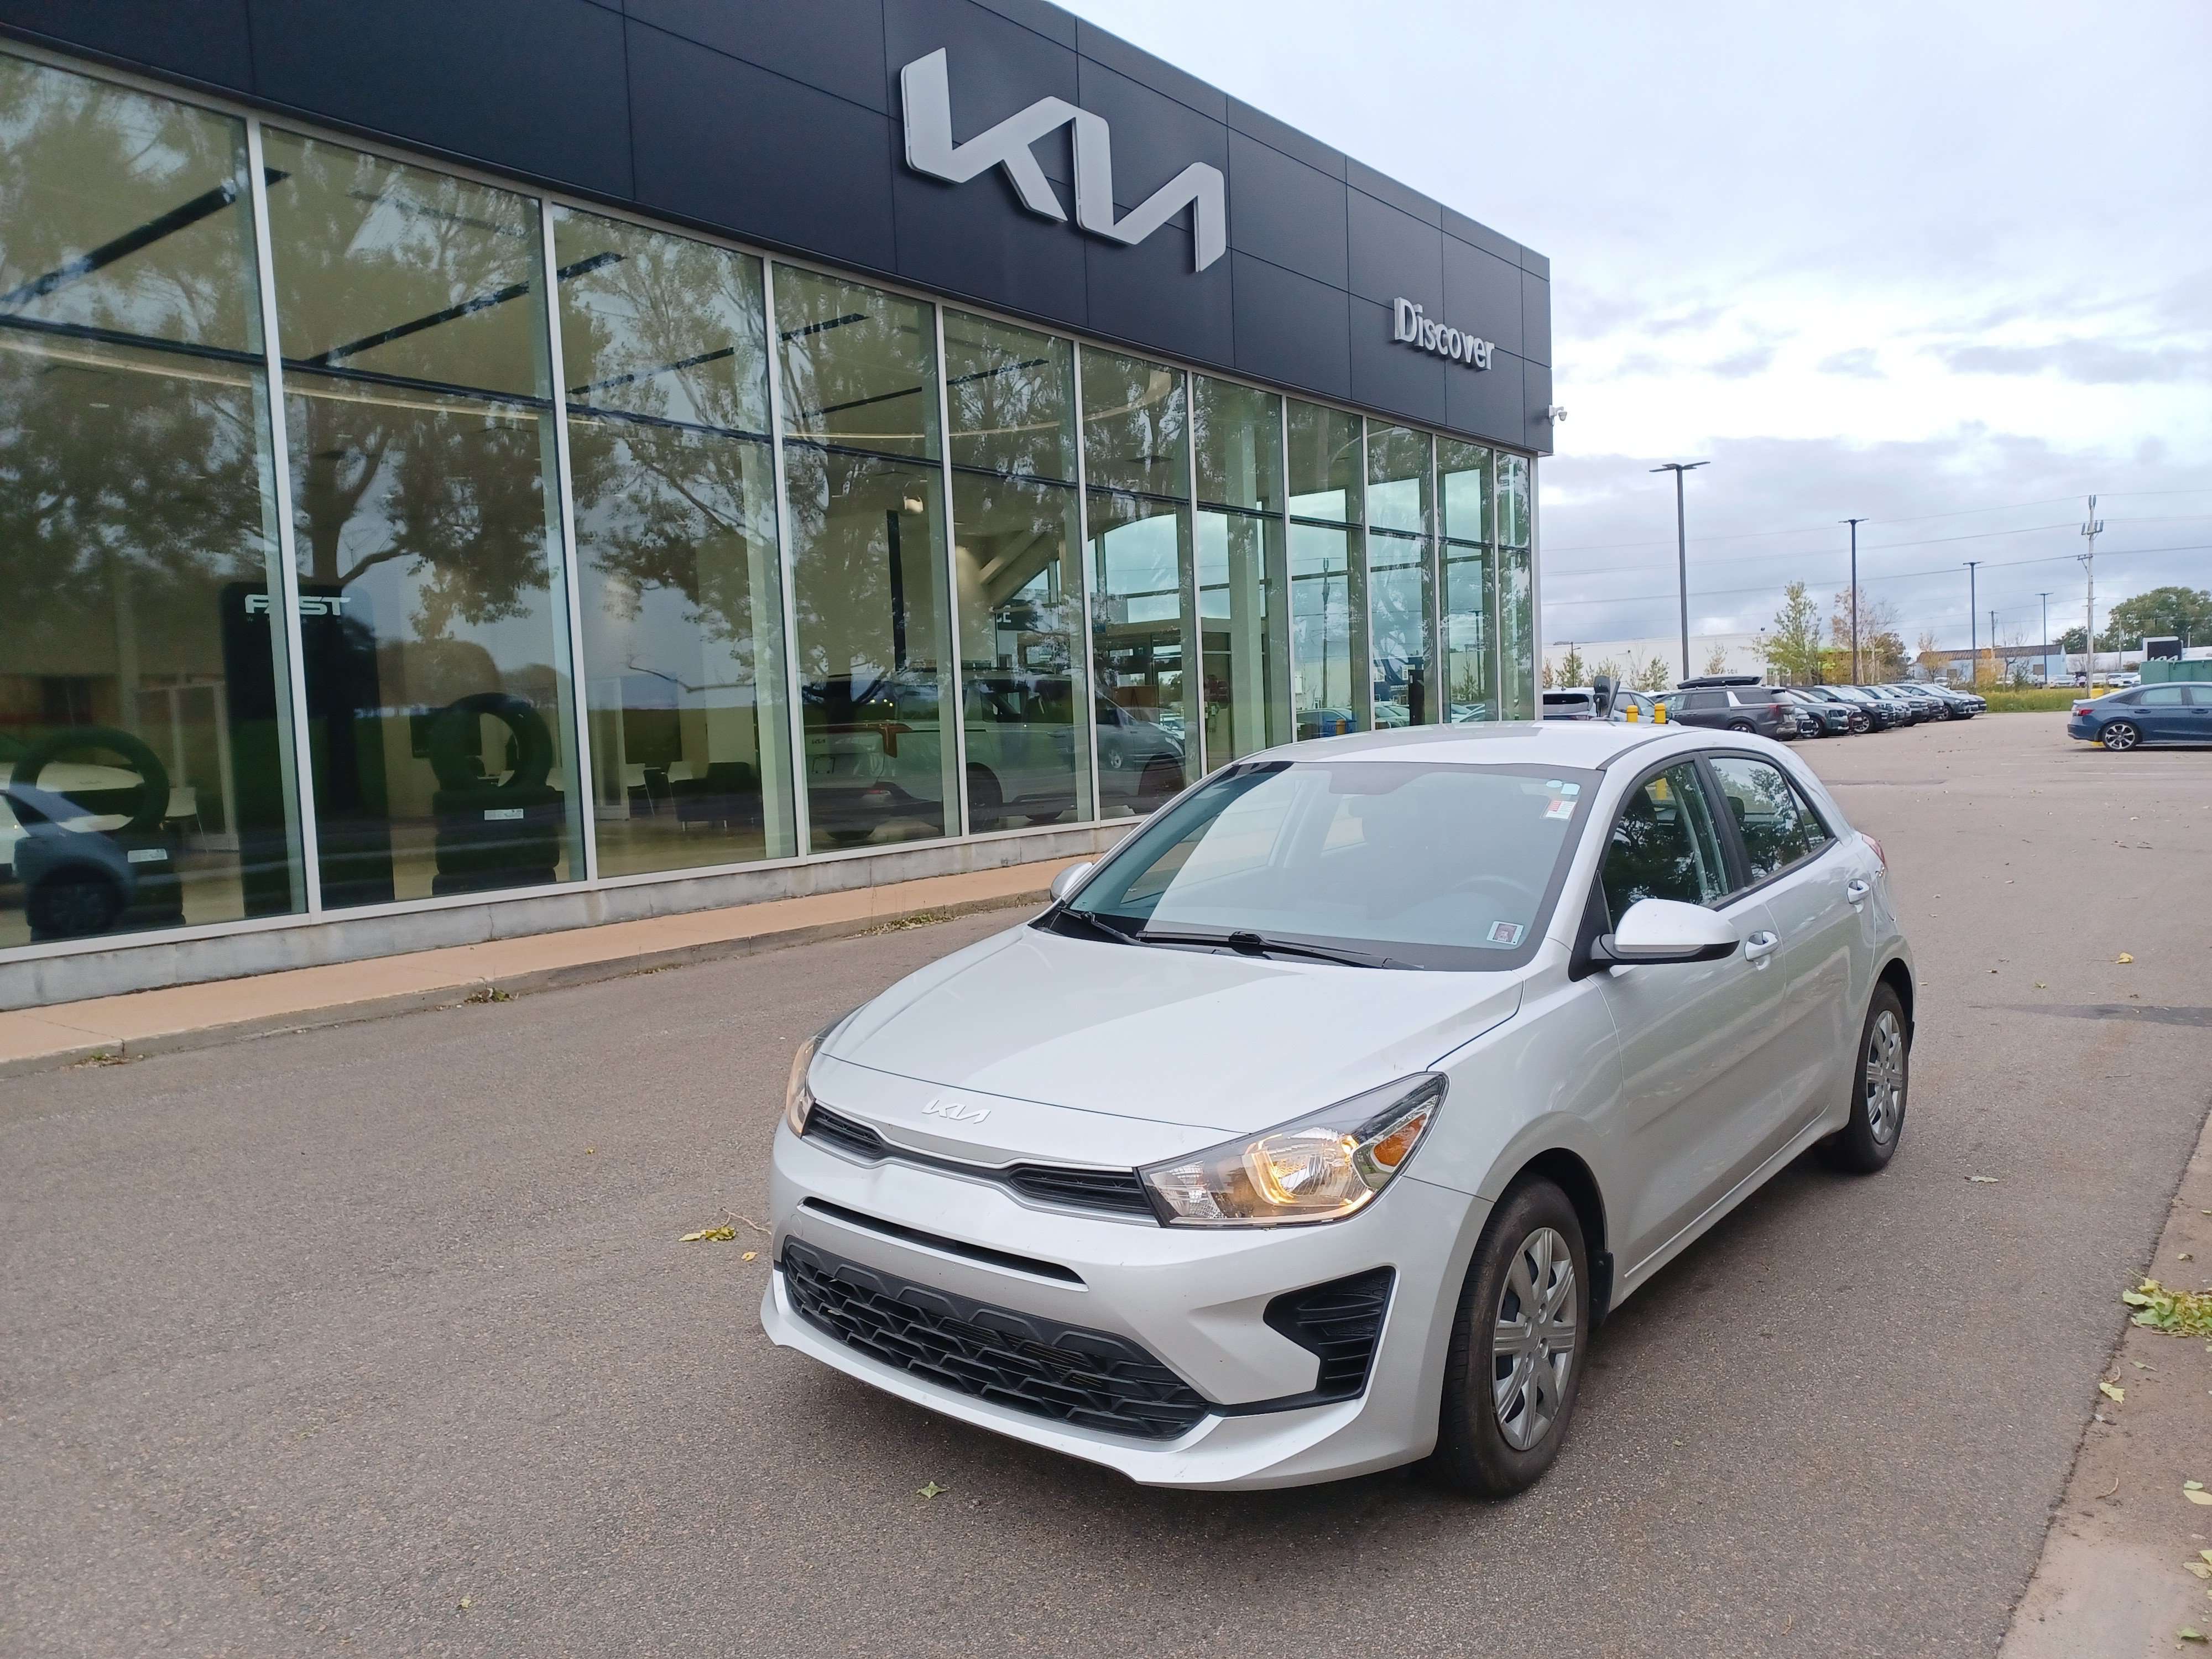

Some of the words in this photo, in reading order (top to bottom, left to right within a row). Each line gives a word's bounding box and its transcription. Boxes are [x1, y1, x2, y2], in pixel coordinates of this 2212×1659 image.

[901, 47, 1227, 272] KIA
[1394, 297, 1495, 370] Discover
[245, 594, 351, 615] FST
[921, 1099, 992, 1124] KIA
